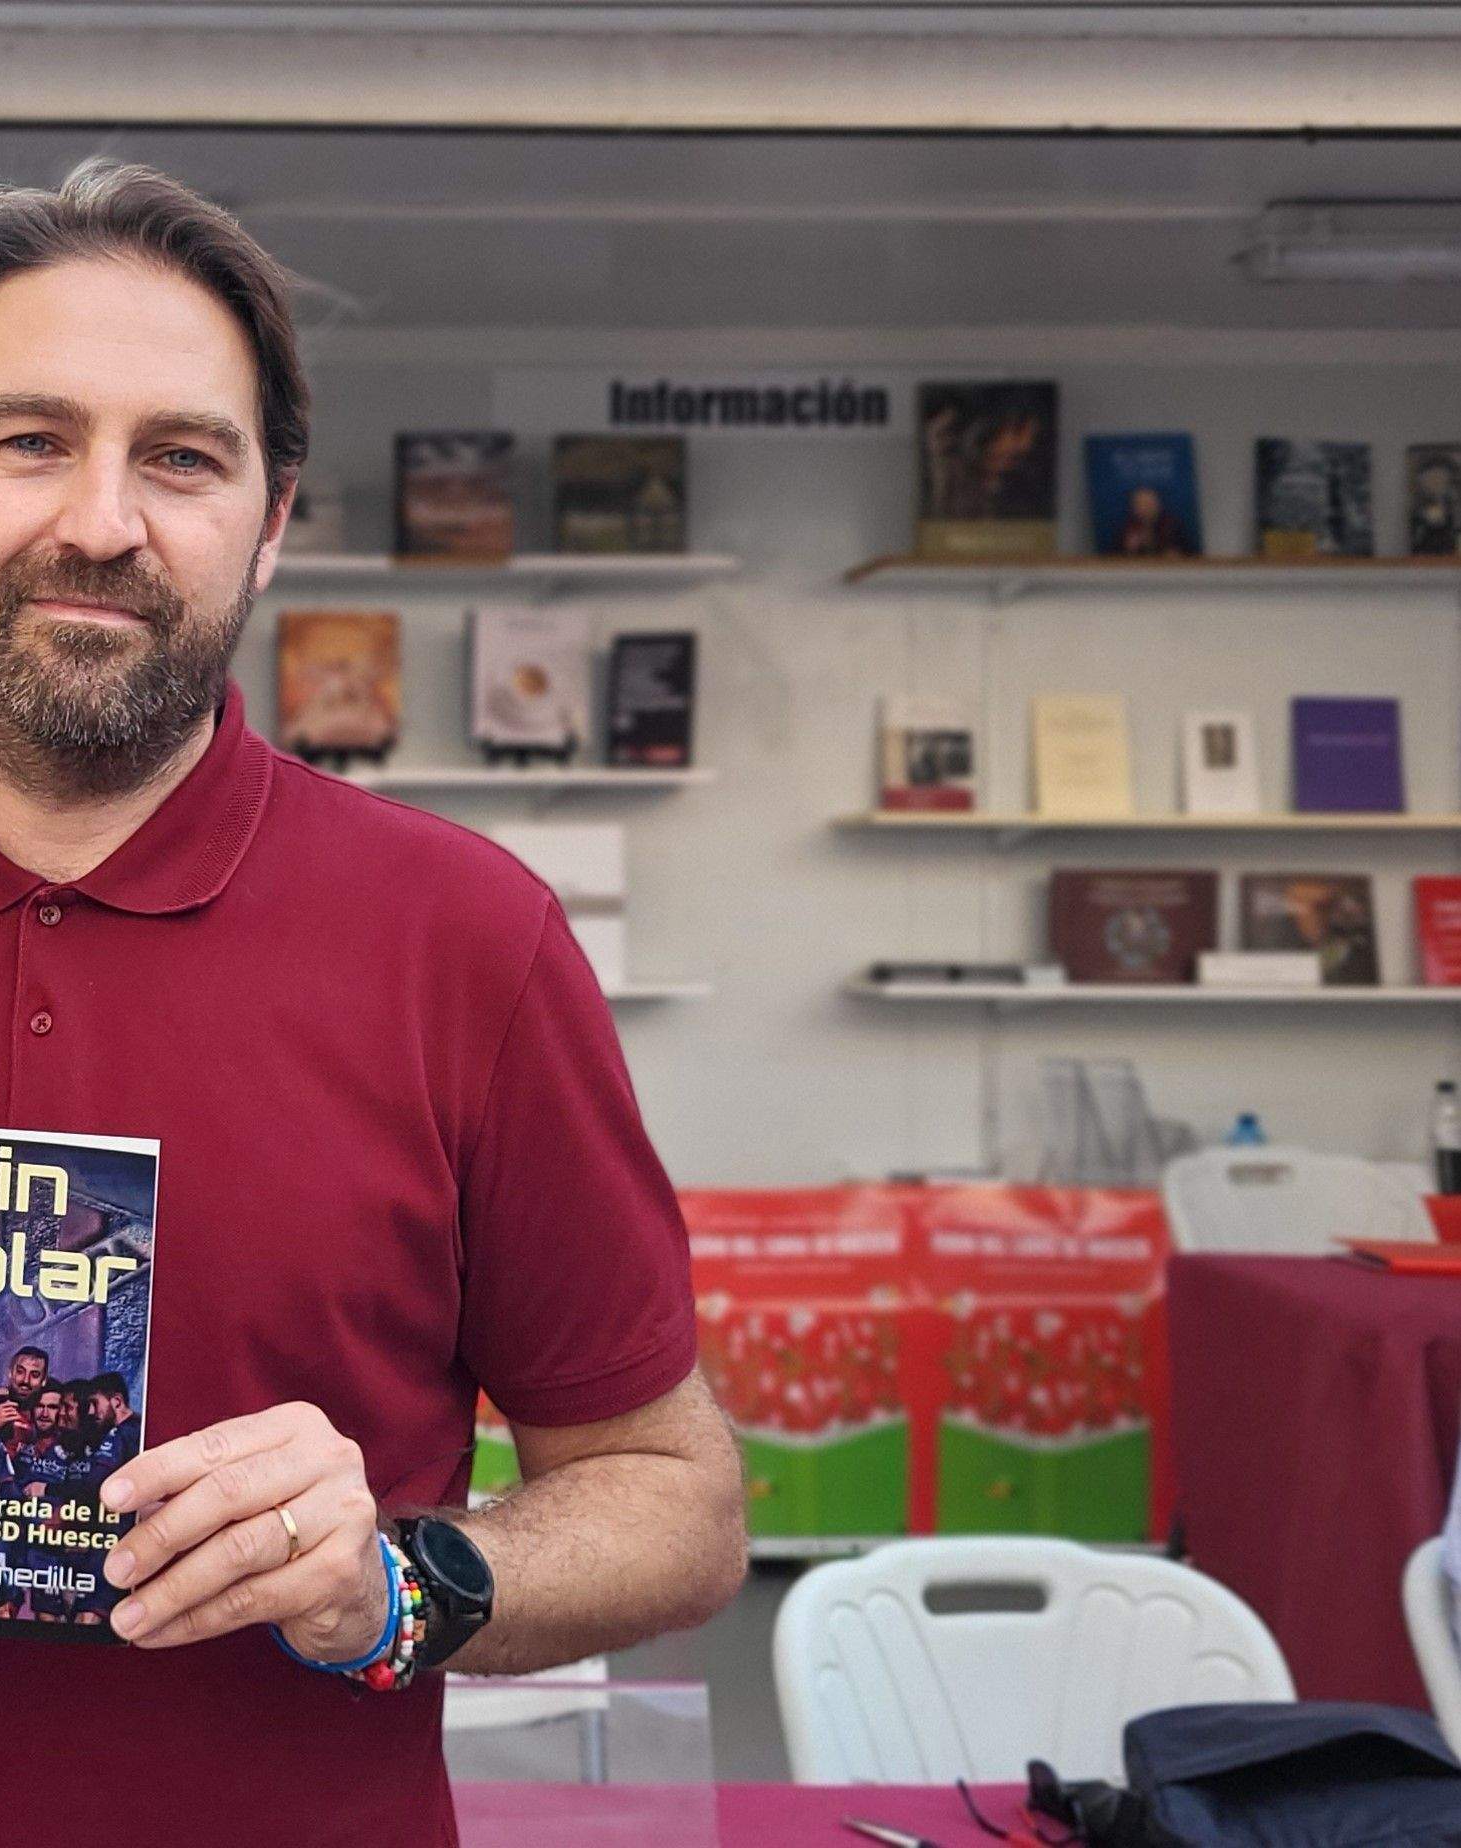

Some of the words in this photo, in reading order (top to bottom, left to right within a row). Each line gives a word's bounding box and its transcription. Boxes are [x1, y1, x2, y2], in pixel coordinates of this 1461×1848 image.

[610, 379, 888, 426] Información
[60, 1500, 91, 1522] de
[99, 1502, 120, 1524] la
[27, 1523, 119, 1549] Huesca
